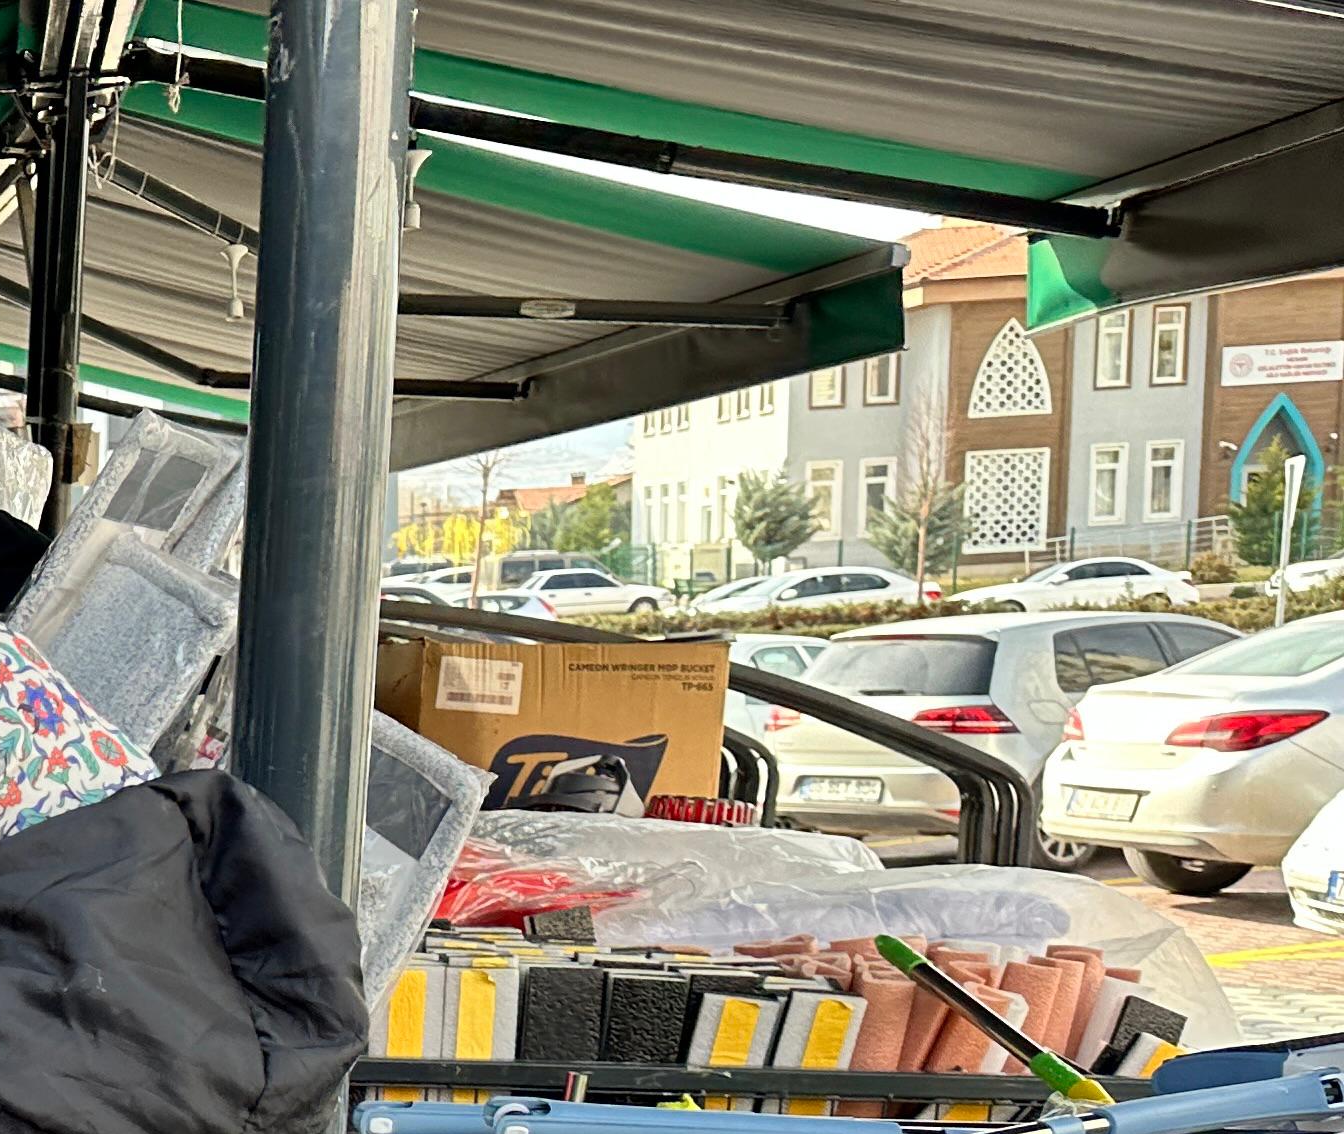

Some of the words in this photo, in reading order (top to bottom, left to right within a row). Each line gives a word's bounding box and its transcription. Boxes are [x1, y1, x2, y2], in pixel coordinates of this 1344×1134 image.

[611, 663, 655, 672] WRINGER
[657, 664, 678, 673] MOP
[679, 664, 715, 673] BUCKET
